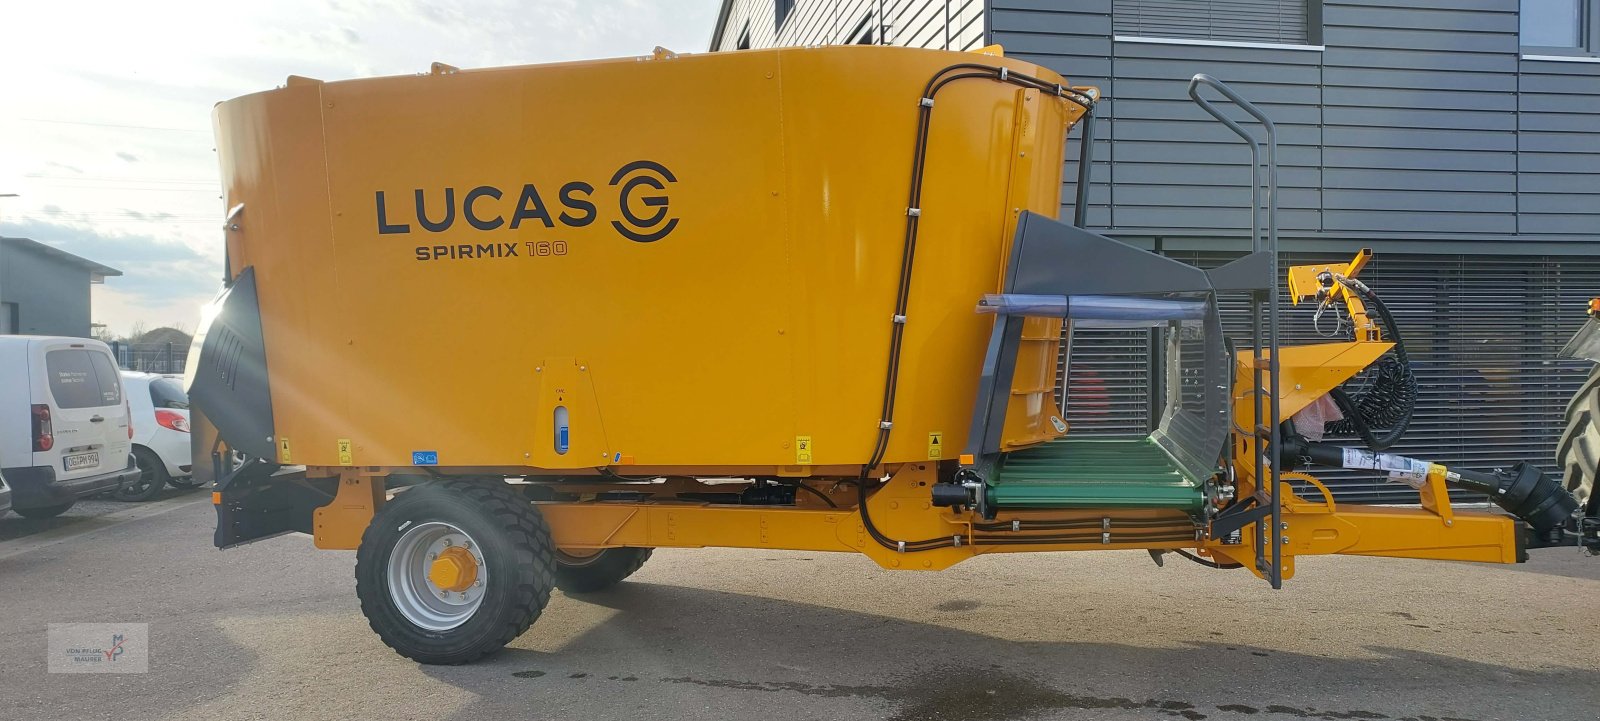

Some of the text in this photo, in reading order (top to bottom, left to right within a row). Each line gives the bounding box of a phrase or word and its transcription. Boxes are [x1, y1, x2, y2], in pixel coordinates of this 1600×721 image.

[375, 181, 597, 235] LUCAS
[415, 240, 568, 261] SPIRMIX 160
